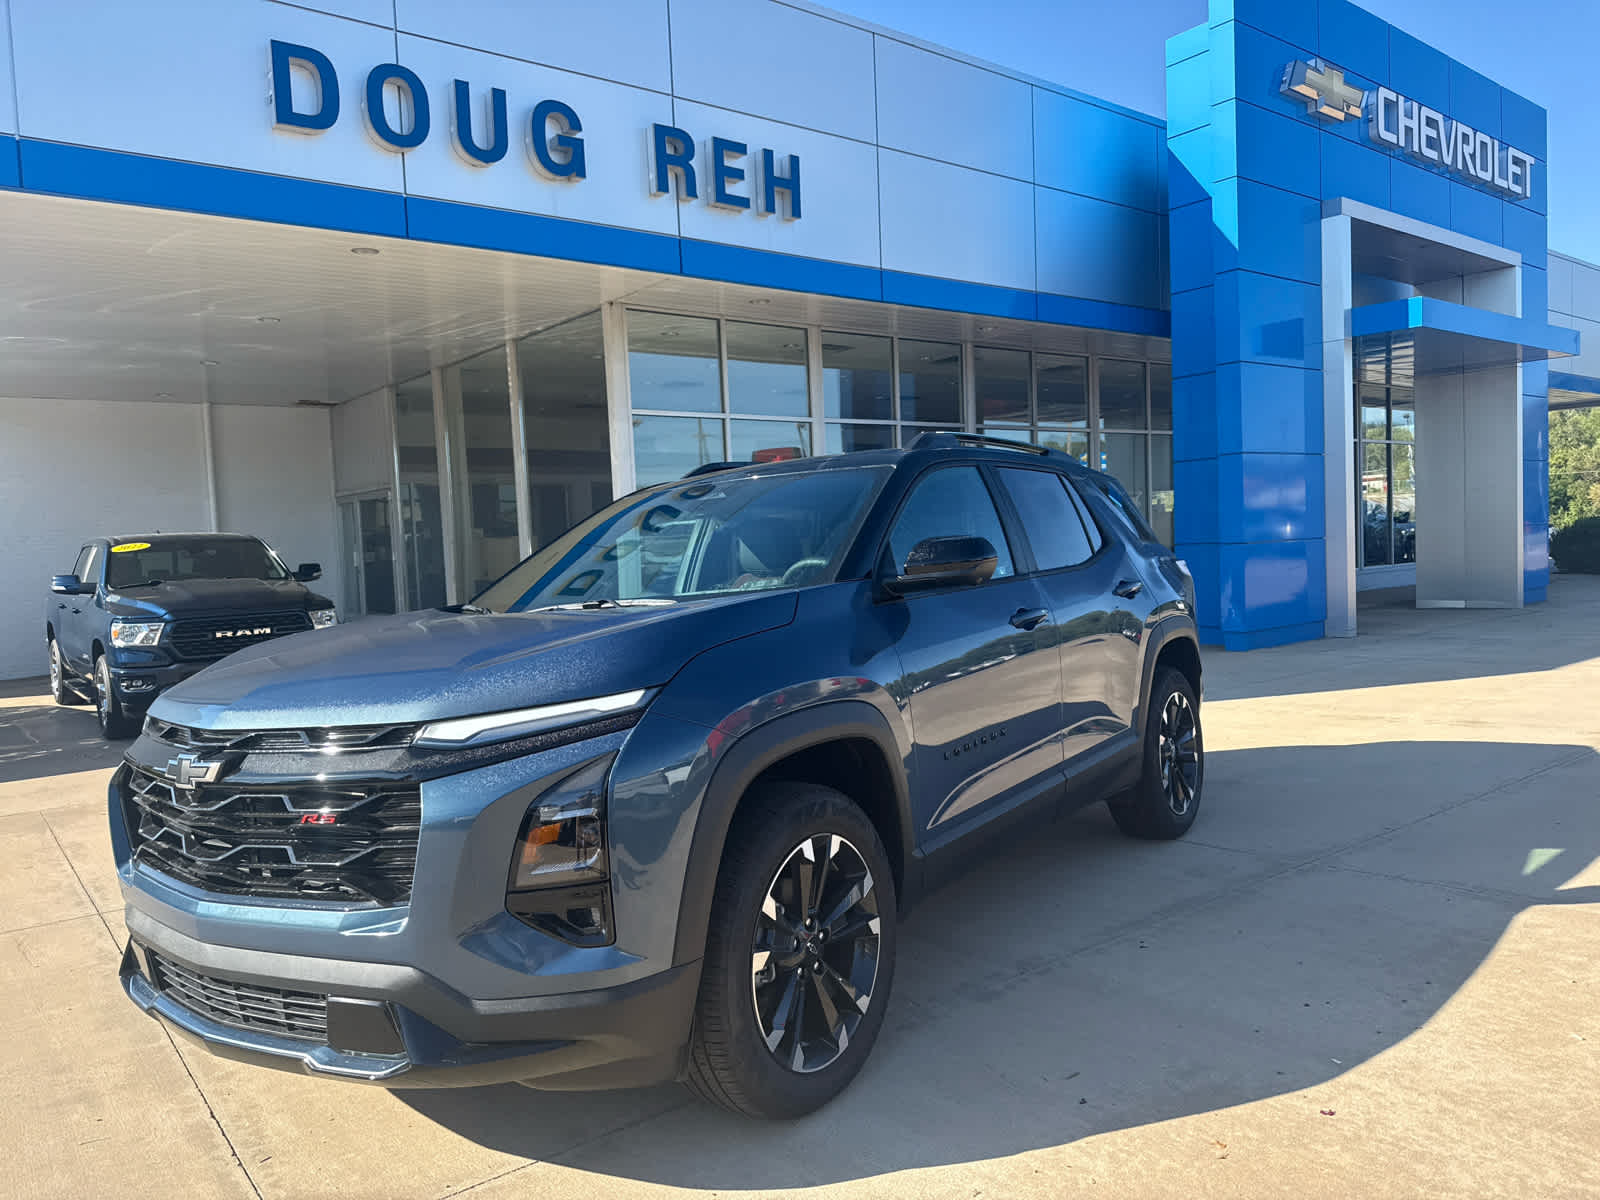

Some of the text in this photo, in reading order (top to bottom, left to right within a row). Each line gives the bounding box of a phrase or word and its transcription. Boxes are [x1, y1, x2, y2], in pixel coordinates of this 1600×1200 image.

[268, 39, 801, 220] DOUG REH
[1374, 86, 1534, 198] CHEVROLET
[215, 627, 271, 638] RAM
[301, 814, 337, 824] RS
